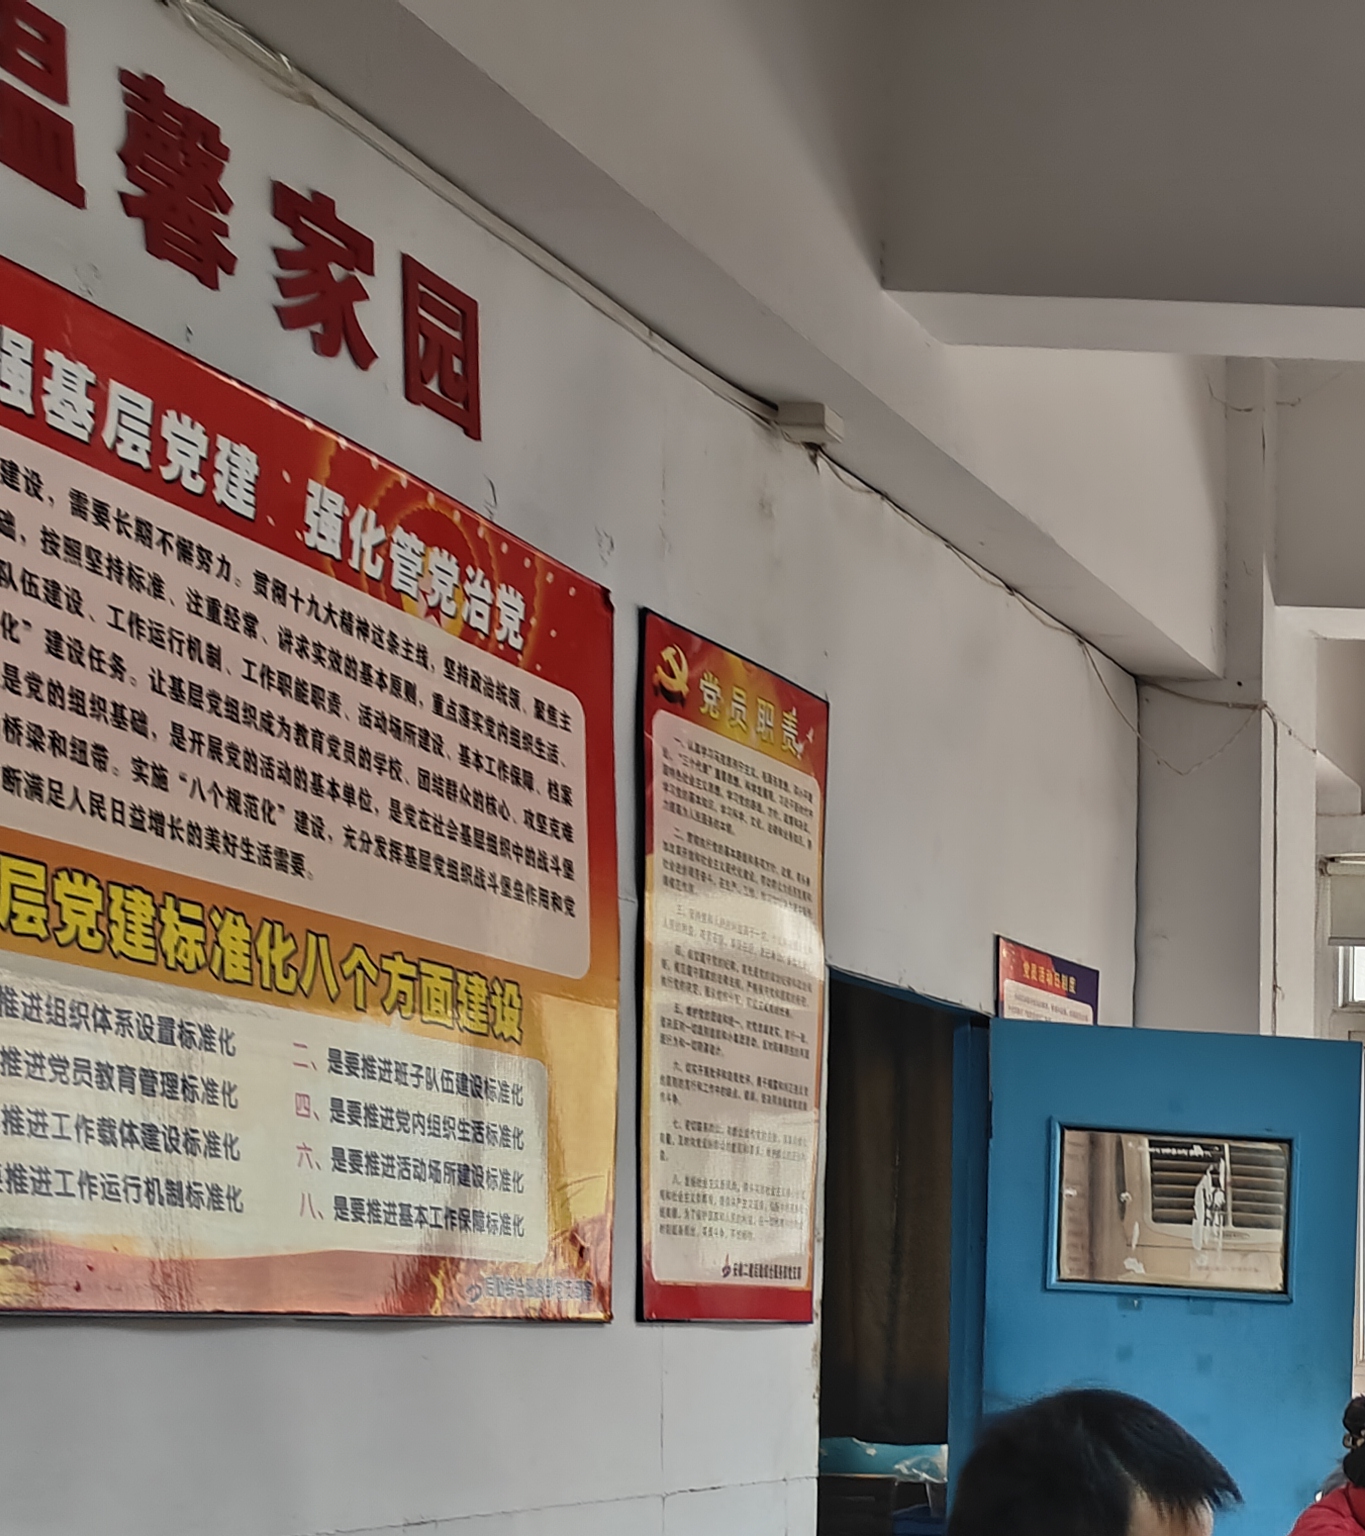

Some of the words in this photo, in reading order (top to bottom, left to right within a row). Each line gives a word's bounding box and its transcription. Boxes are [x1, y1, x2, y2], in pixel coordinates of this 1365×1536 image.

[303, 478, 525, 651] 强化管党治党
[699, 672, 799, 756] 党员职责
[0, 1163, 244, 1213] 推进工作运行机制标准化
